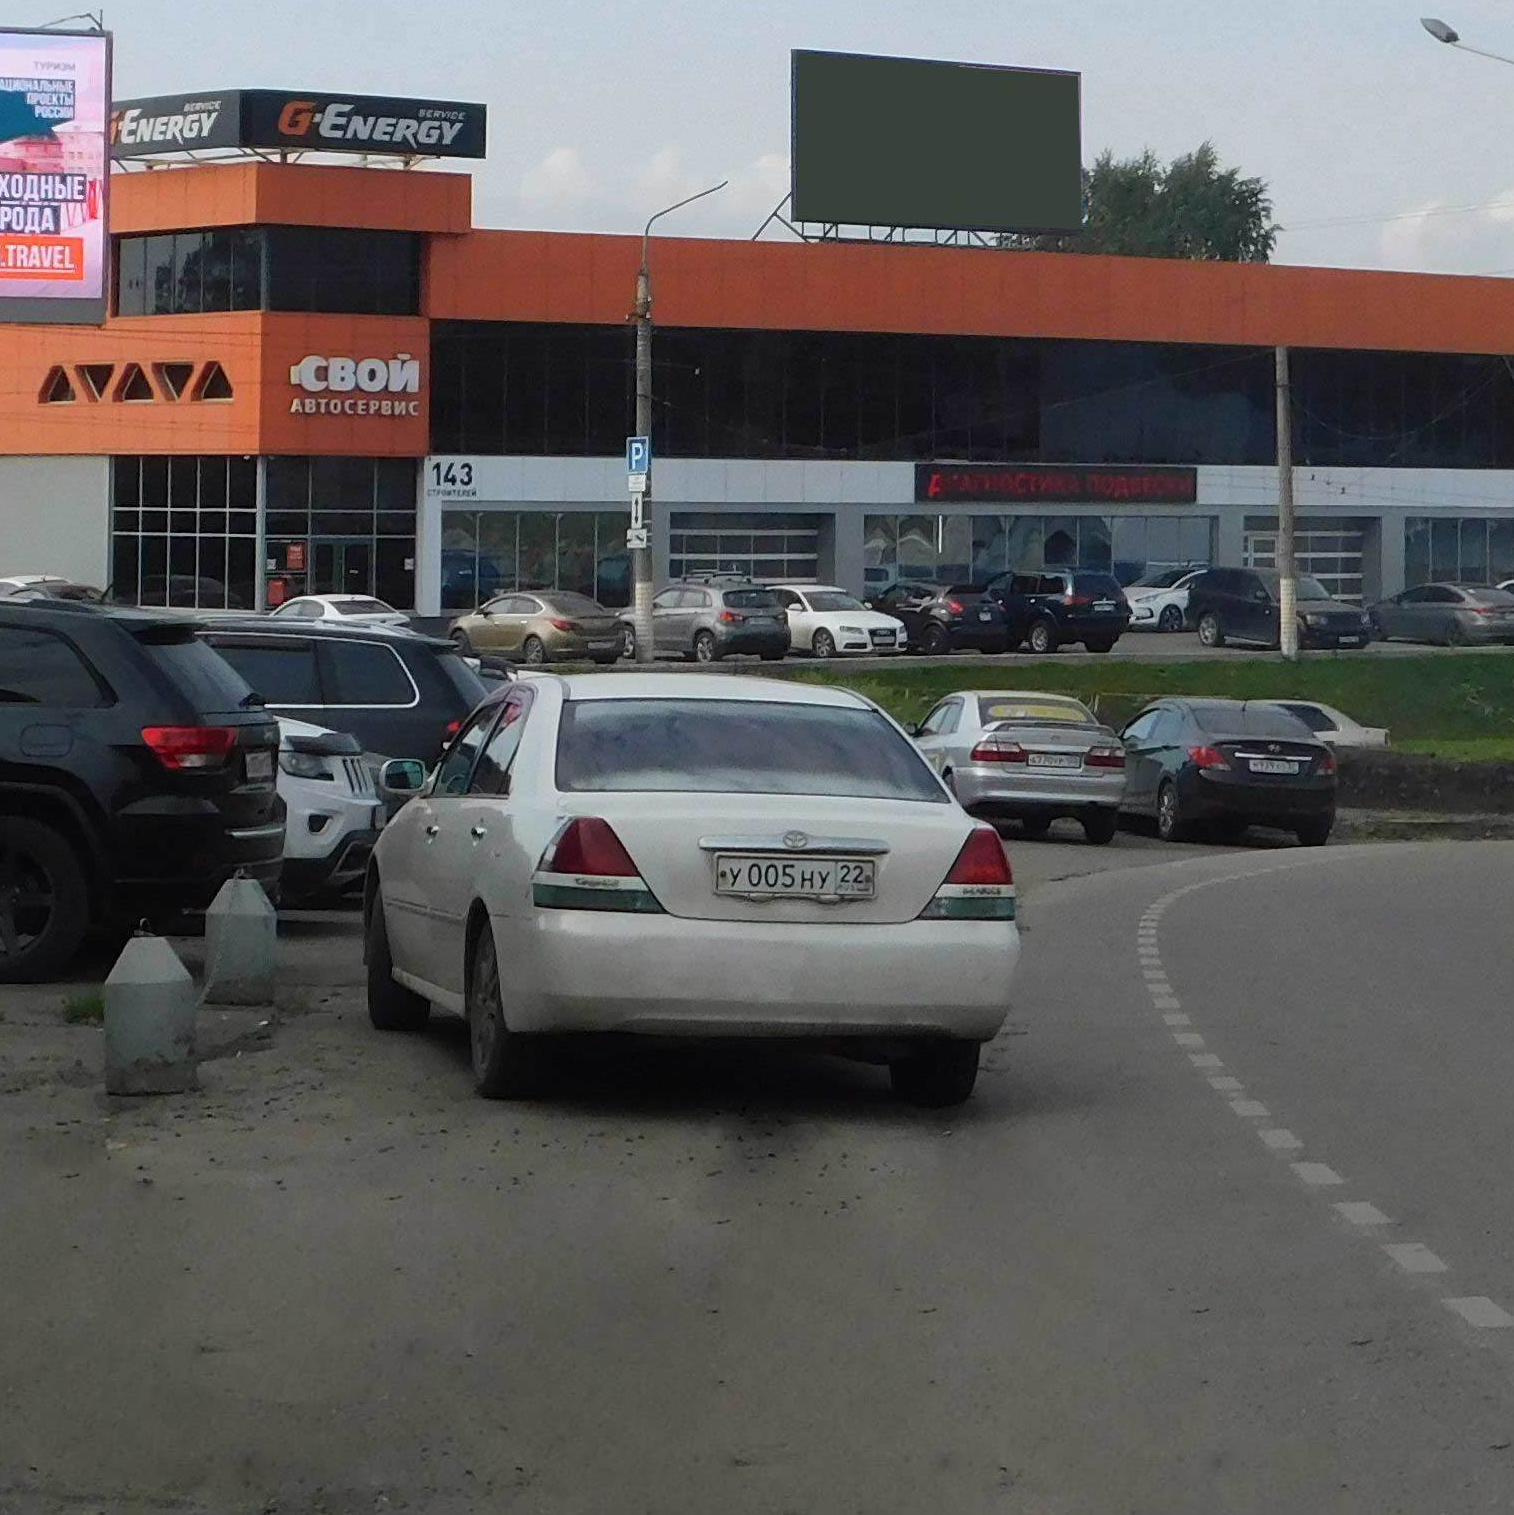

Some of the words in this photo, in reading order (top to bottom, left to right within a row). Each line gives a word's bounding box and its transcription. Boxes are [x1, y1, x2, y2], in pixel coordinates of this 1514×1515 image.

[34, 61, 76, 71] ТУРИЗМ
[27, 92, 74, 105] ПРОЕКТЫ
[34, 105, 74, 118] РОССИИ
[418, 108, 466, 120] SERVICE
[295, 353, 420, 393] СВОЙ
[290, 397, 420, 416] АВТОСЕРВИС
[432, 462, 473, 486] 143
[840, 865, 864, 883] 22
